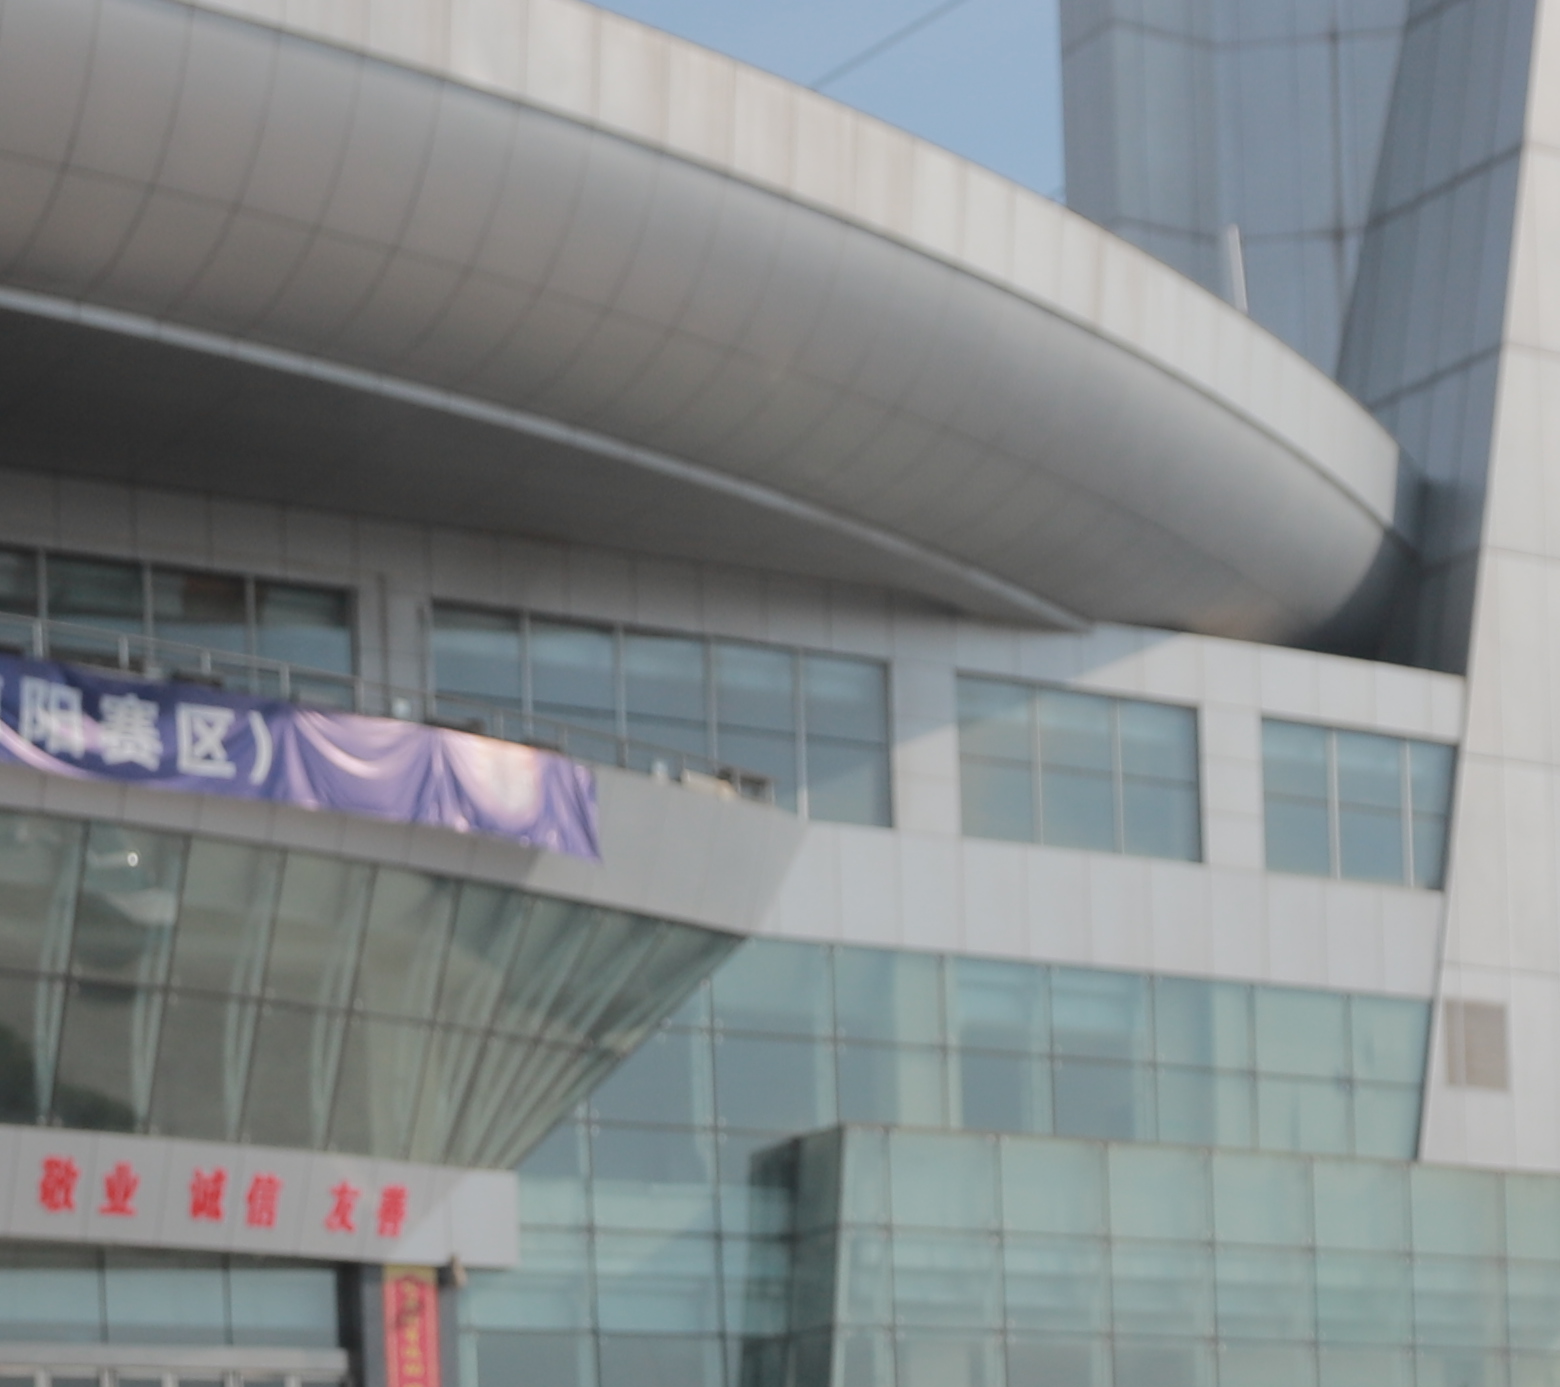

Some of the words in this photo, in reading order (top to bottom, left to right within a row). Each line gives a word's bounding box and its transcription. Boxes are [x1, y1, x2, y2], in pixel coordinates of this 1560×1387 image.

[38, 1156, 140, 1217] 敬业
[188, 1167, 283, 1229] 诚信
[324, 1181, 410, 1238] 友善
